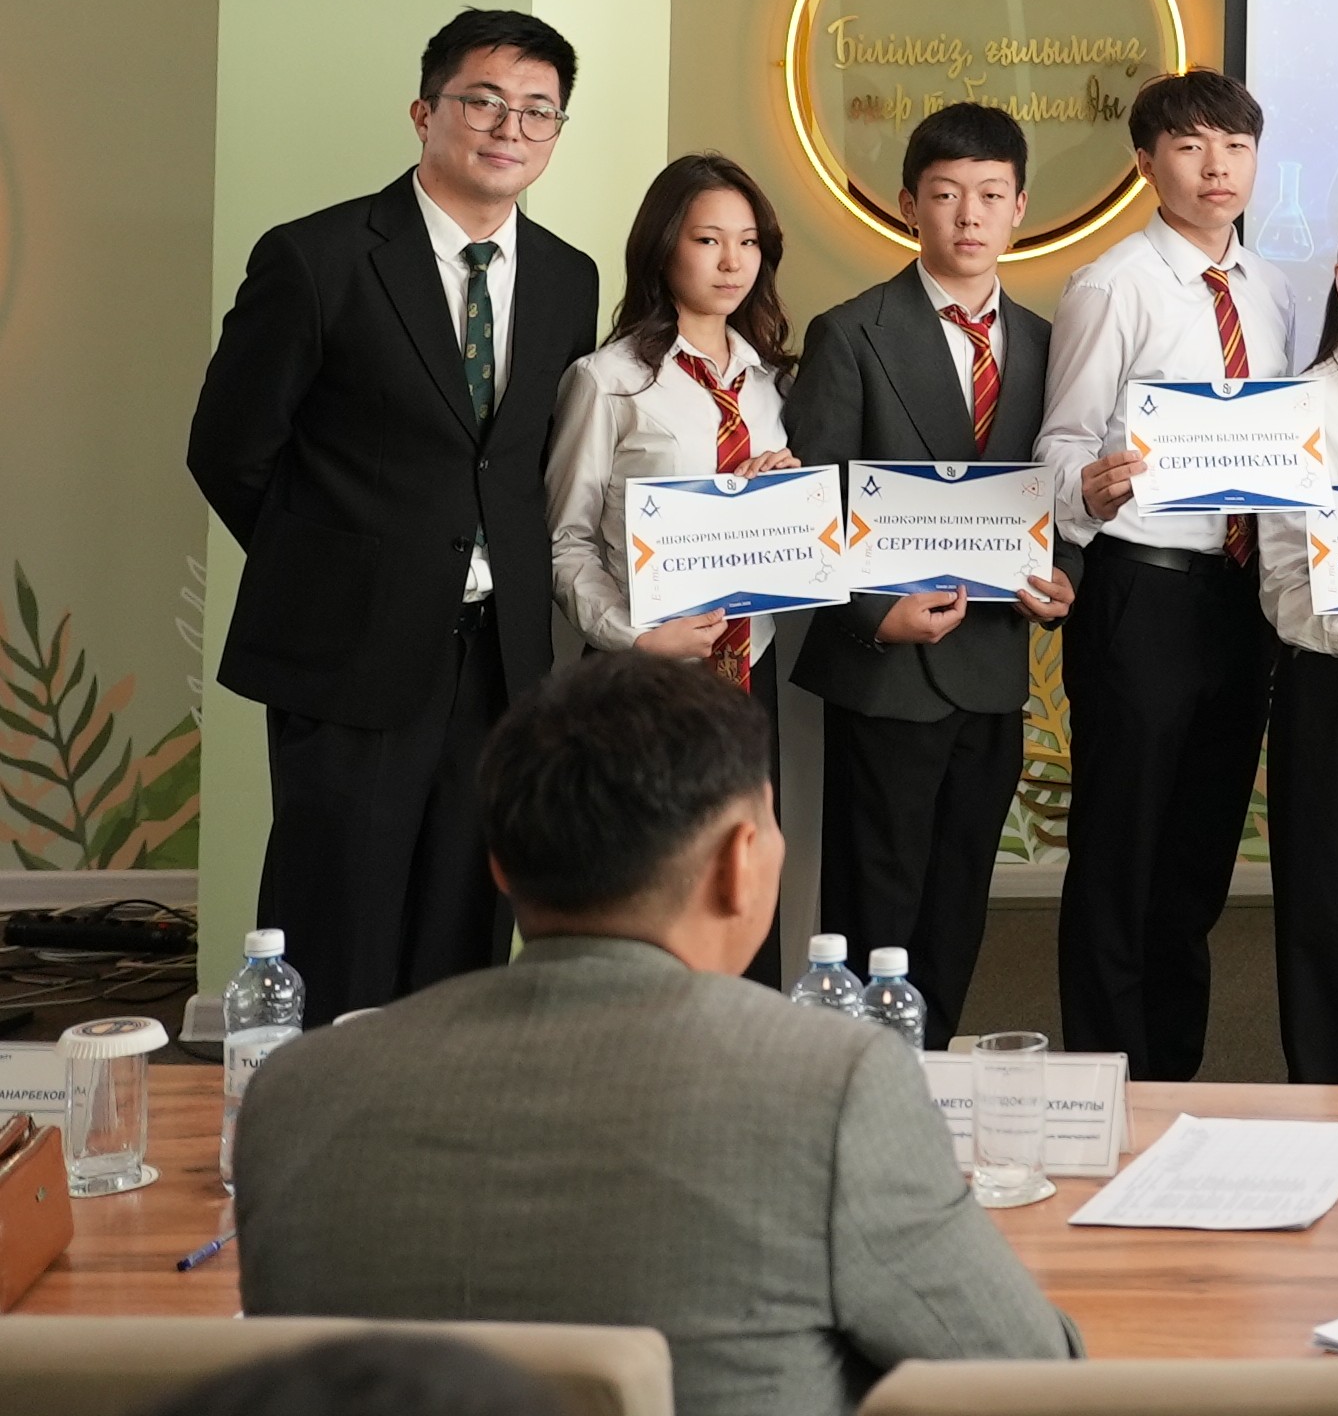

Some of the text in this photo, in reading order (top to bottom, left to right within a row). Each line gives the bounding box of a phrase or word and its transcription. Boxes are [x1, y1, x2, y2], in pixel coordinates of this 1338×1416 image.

[1159, 453, 1299, 470] СЕРТИФИКАТЫ
[939, 515, 973, 525] БІЛІМ
[877, 537, 1022, 552] СЕРТИФИКАТЫ
[662, 546, 814, 573] СЕРТИФИКАТЫ
[0, 1089, 66, 1101] АНАРБЕКОВ
[1046, 1099, 1105, 1112] ХТАРҰЛЫ
